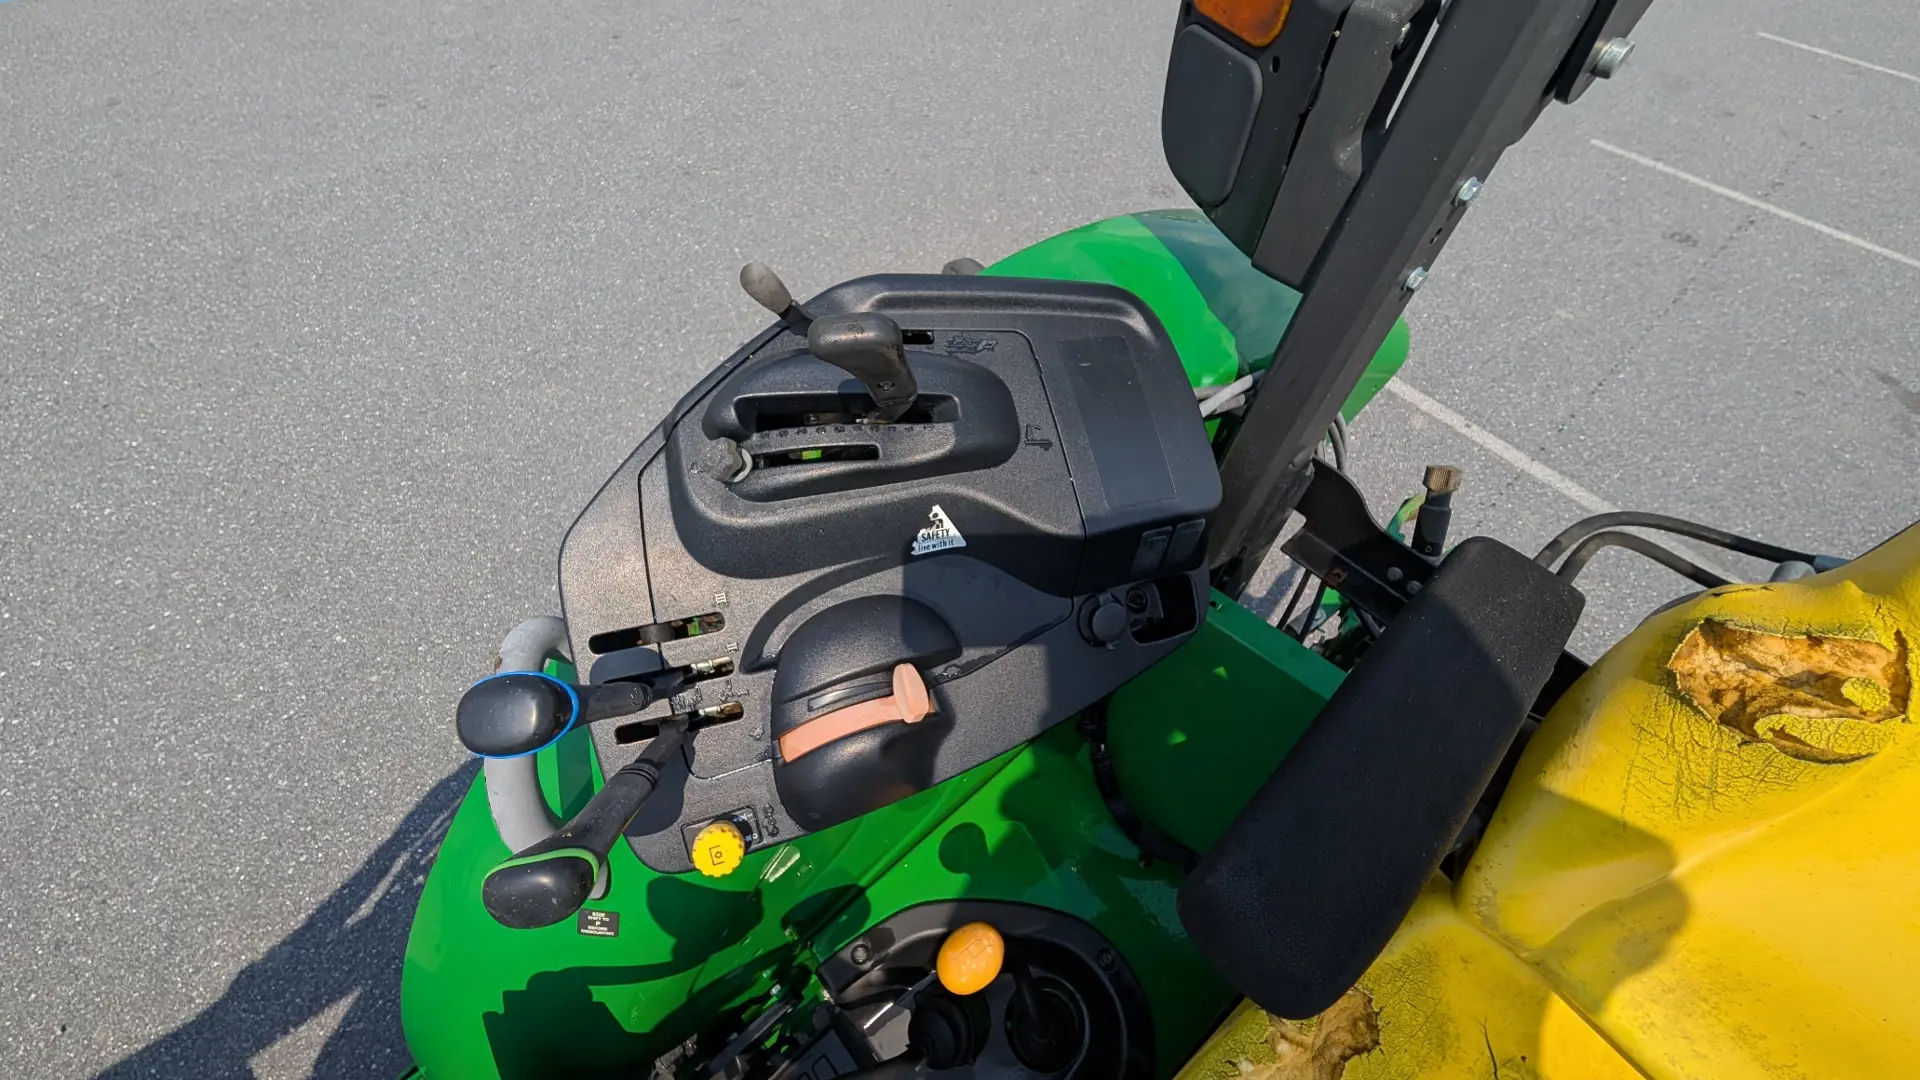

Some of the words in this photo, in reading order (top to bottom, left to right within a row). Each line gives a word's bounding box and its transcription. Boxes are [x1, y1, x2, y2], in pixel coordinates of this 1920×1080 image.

[921, 528, 950, 542] SAFETY
[918, 544, 930, 553] live
[932, 539, 947, 549] with
[948, 537, 954, 547] it
